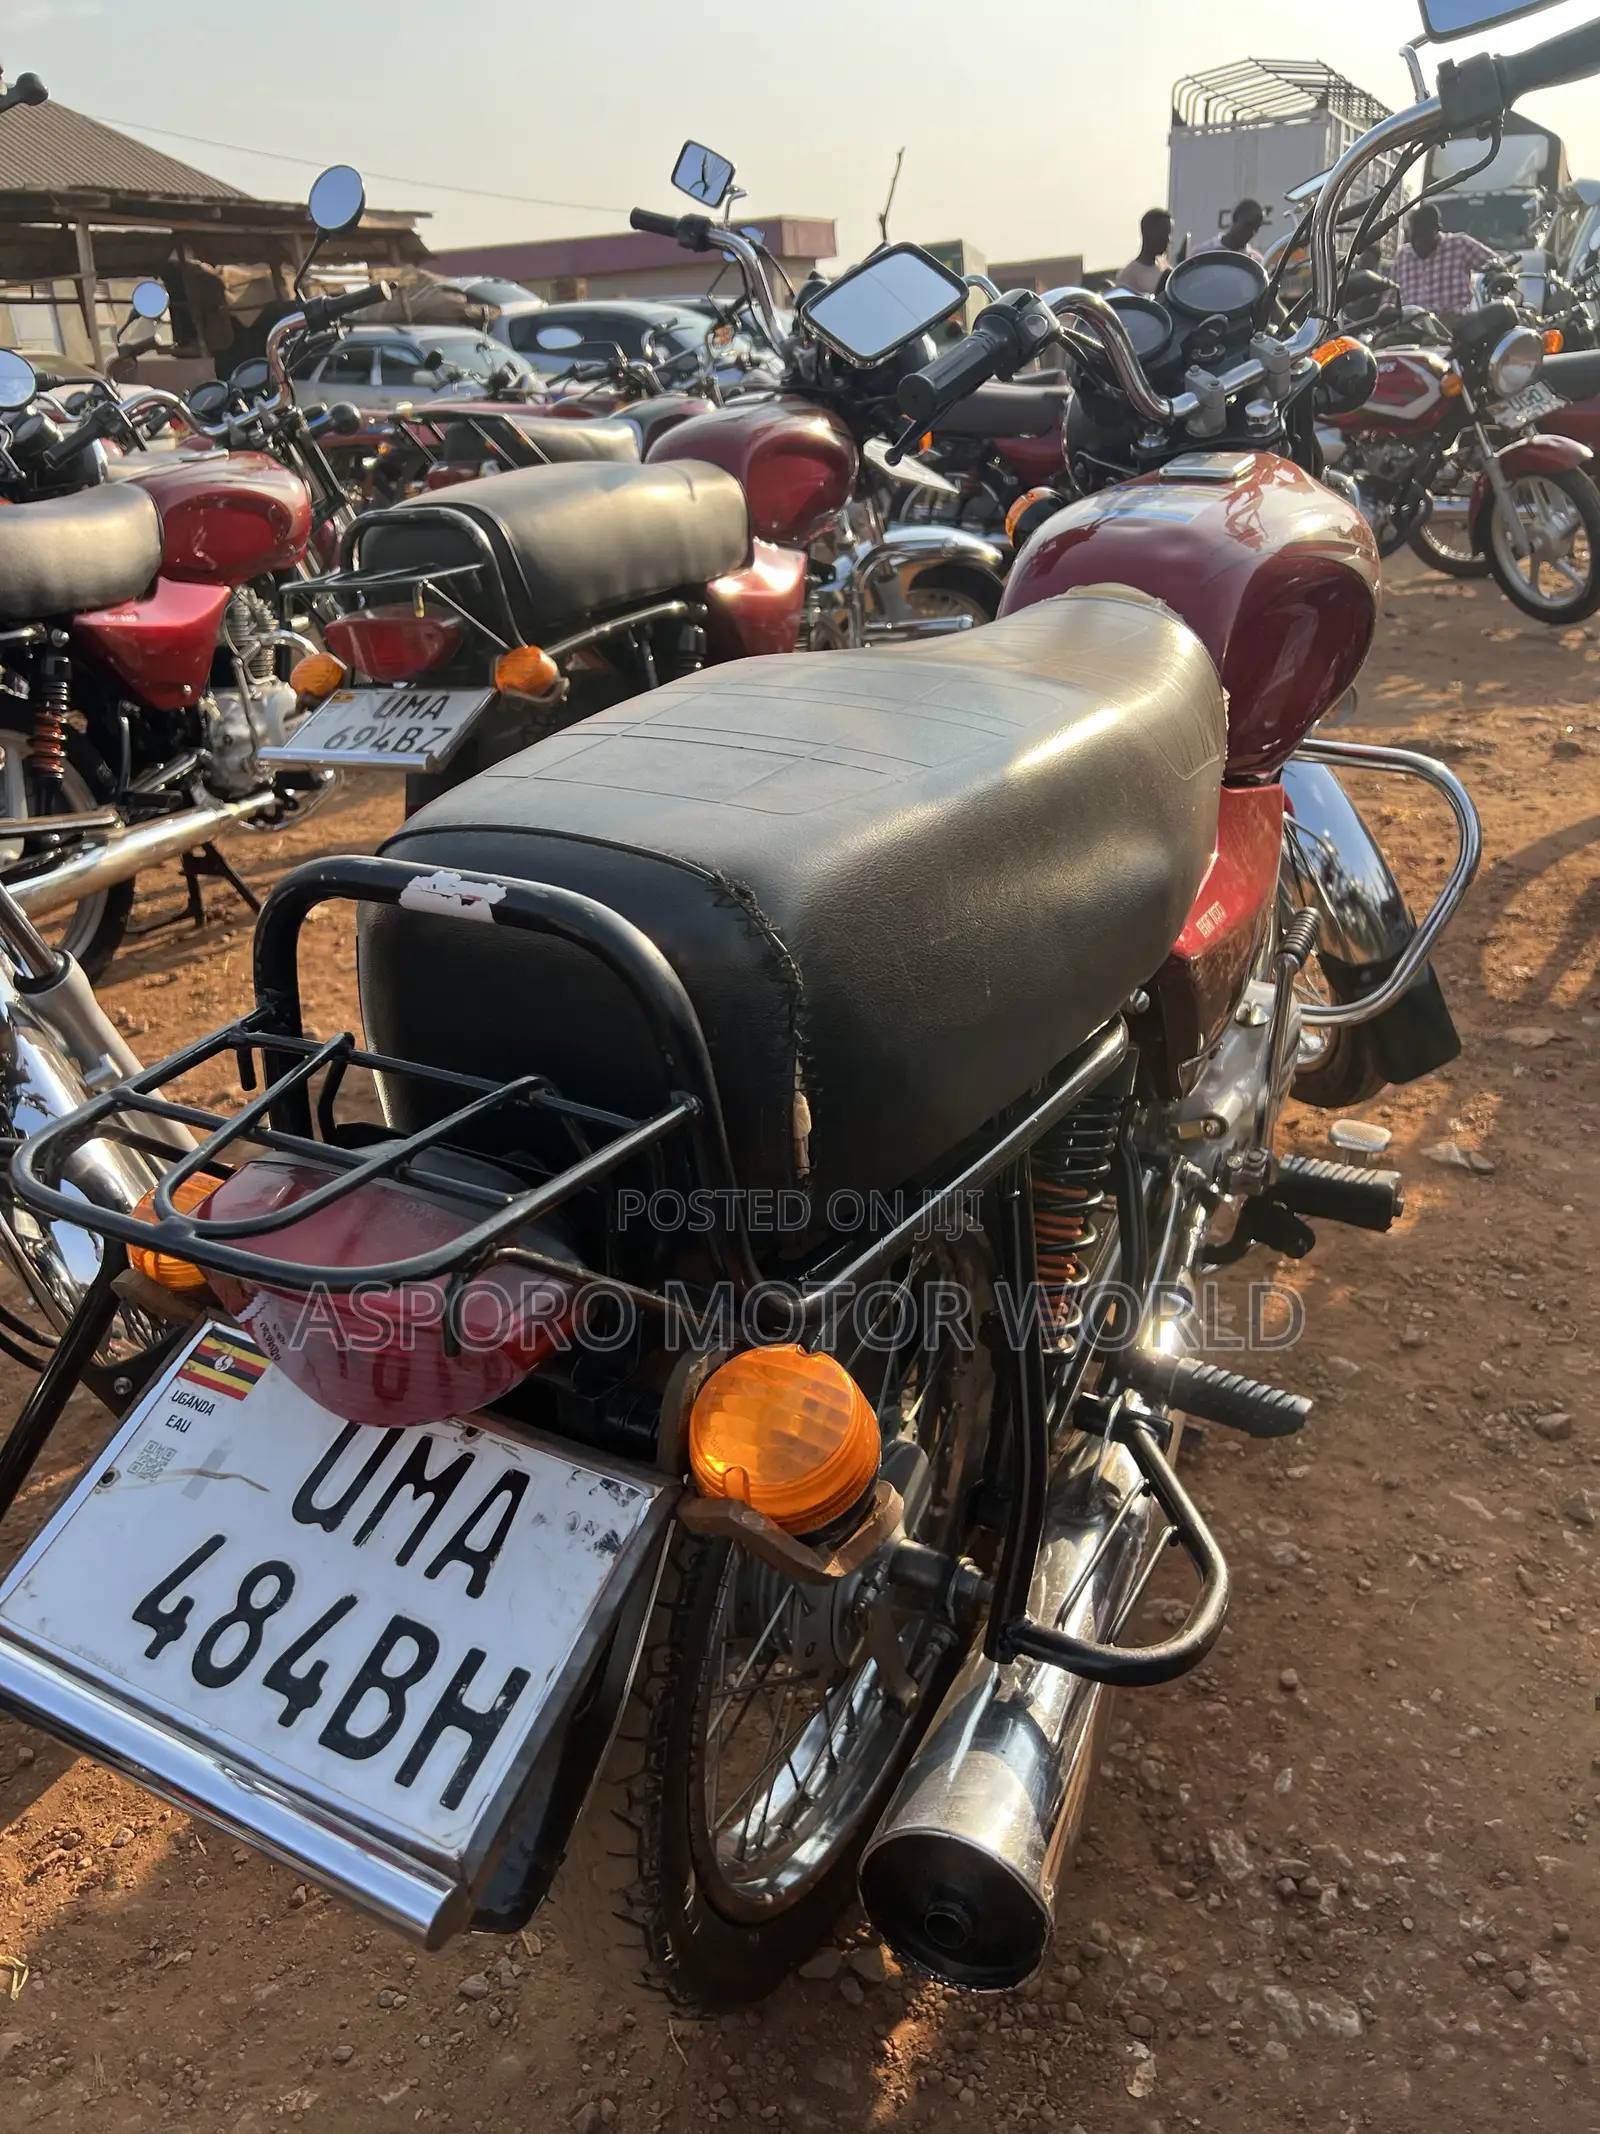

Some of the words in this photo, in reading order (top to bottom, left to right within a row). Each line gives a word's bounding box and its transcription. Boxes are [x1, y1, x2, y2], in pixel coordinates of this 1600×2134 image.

[372, 692, 452, 720] UMA
[323, 726, 453, 754] 694BZ
[170, 1389, 216, 1417] UGANDA
[165, 1414, 192, 1434] EAU
[291, 1419, 531, 1599] UMA
[132, 1533, 532, 1811] 484BH
